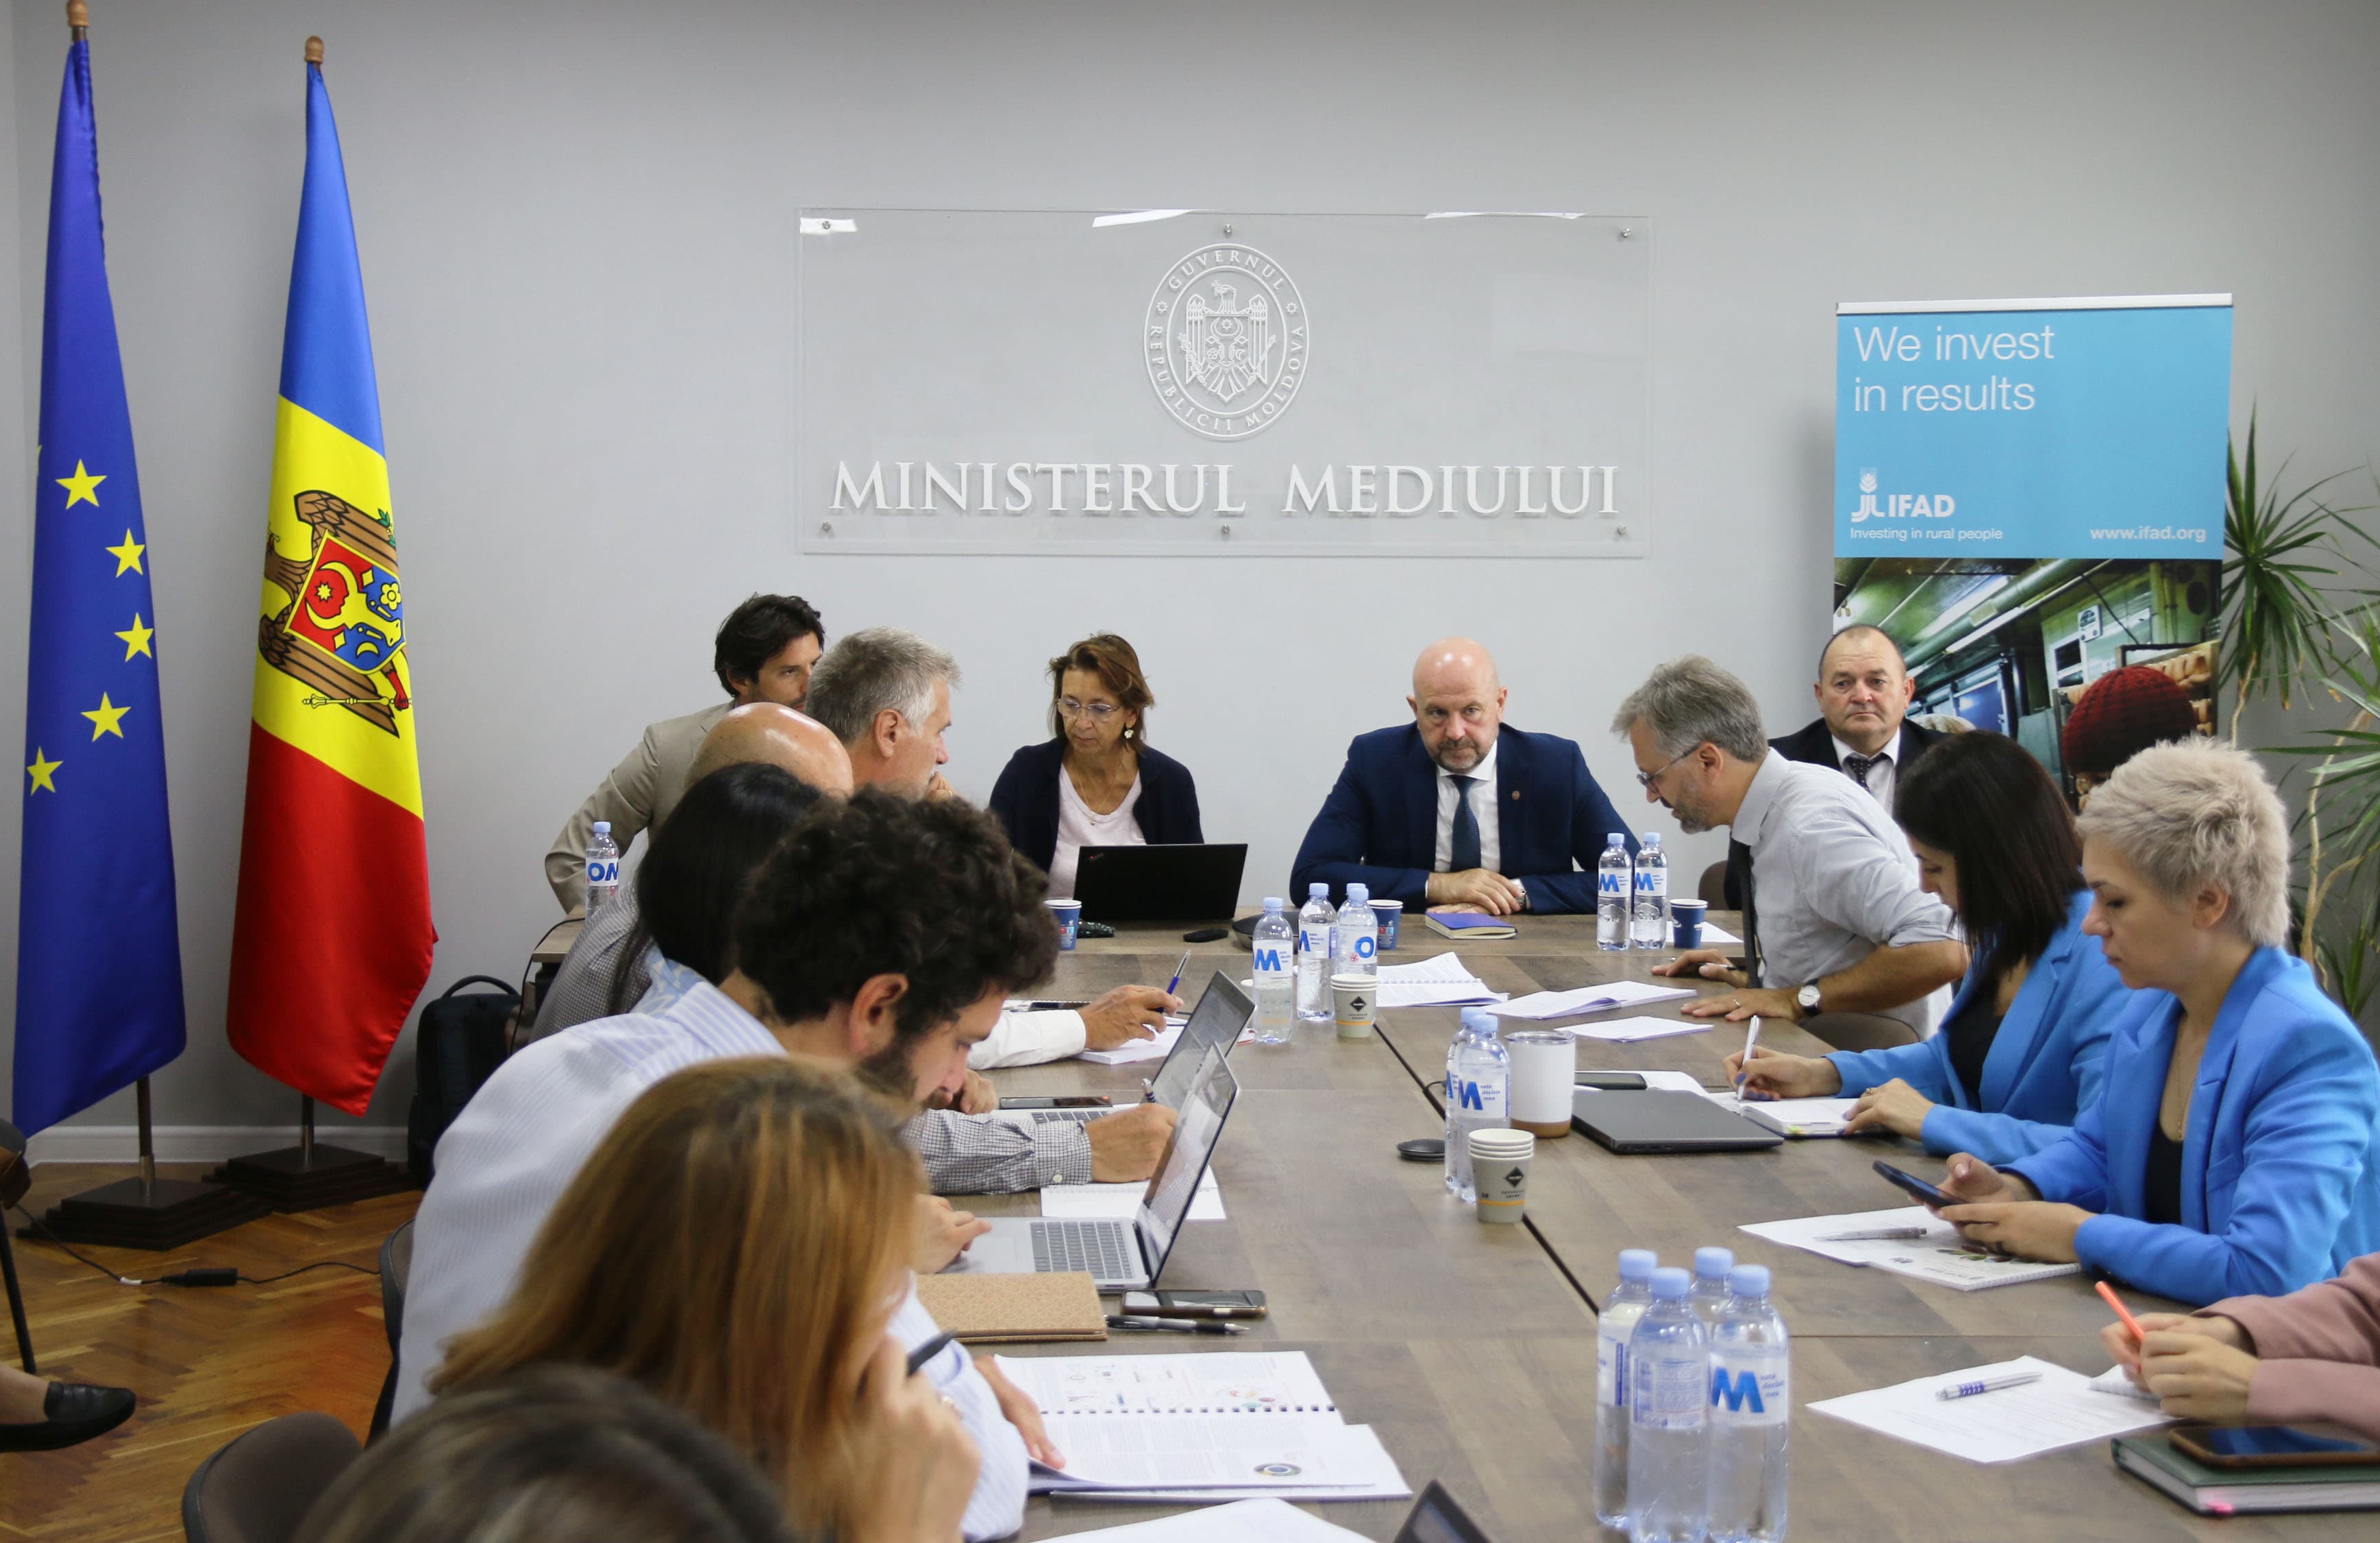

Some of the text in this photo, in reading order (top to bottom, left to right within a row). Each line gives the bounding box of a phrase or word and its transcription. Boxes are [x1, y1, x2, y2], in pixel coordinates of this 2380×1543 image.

[1168, 250, 1284, 290] GUVERNUL
[1854, 325, 2055, 362] We invest
[1150, 325, 1304, 431] REPUBLICII MOLDOVA
[1855, 375, 2036, 412] in results
[828, 461, 1620, 516] MINISTERUL MEDIULUI
[1889, 495, 1955, 518] IFAD
[1850, 527, 2003, 541] Investing in rural people
[2090, 525, 2207, 543] www.ifad.org
[1598, 874, 1620, 892] M
[1254, 949, 1281, 971] M
[1711, 1366, 1764, 1413] M
